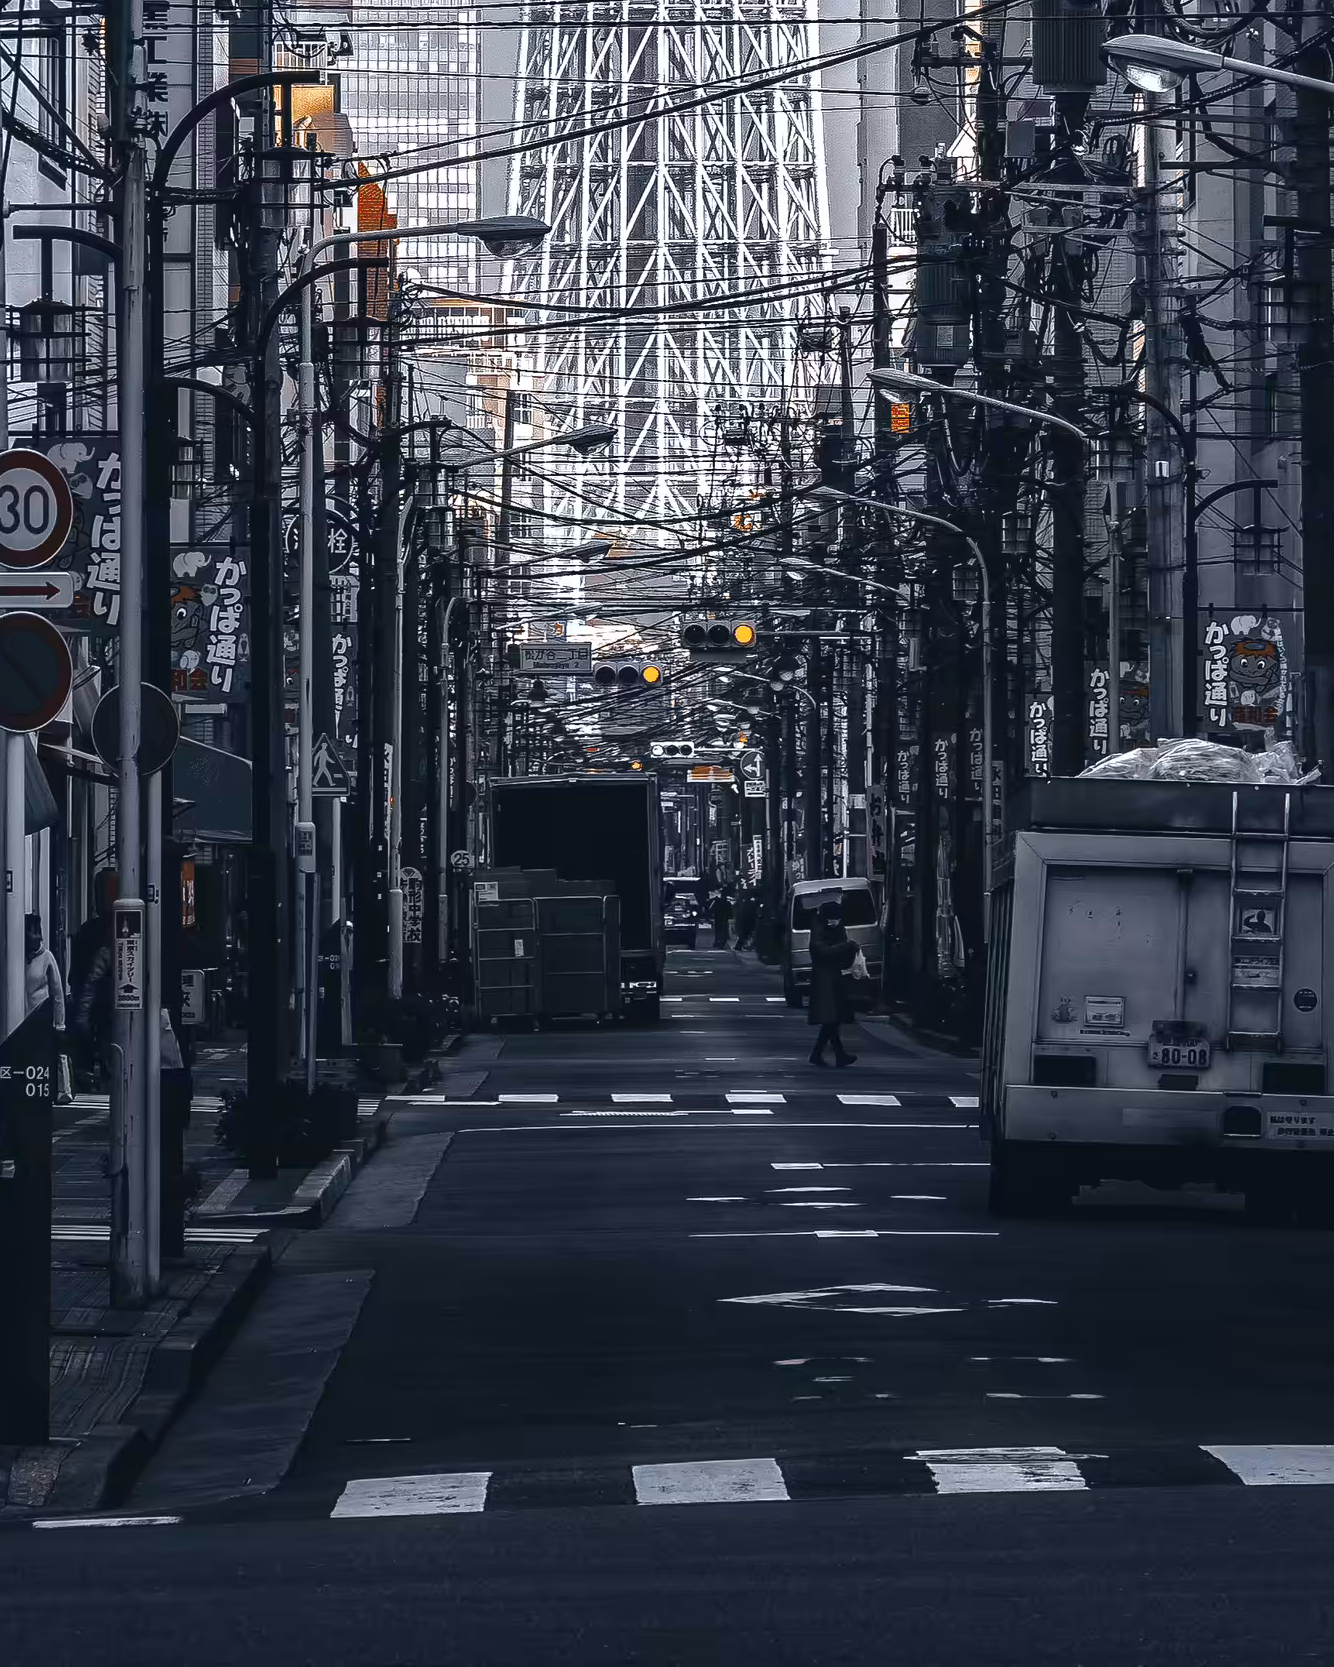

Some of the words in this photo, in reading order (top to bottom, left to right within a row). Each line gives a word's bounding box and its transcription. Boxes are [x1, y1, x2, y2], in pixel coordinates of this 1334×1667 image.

[206, 556, 248, 694] かっぱ通り
[1089, 668, 1110, 755] かっぱ通り
[1205, 621, 1230, 727] かっぱ通り
[454, 852, 470, 866] 25
[25, 1082, 50, 1097] 015
